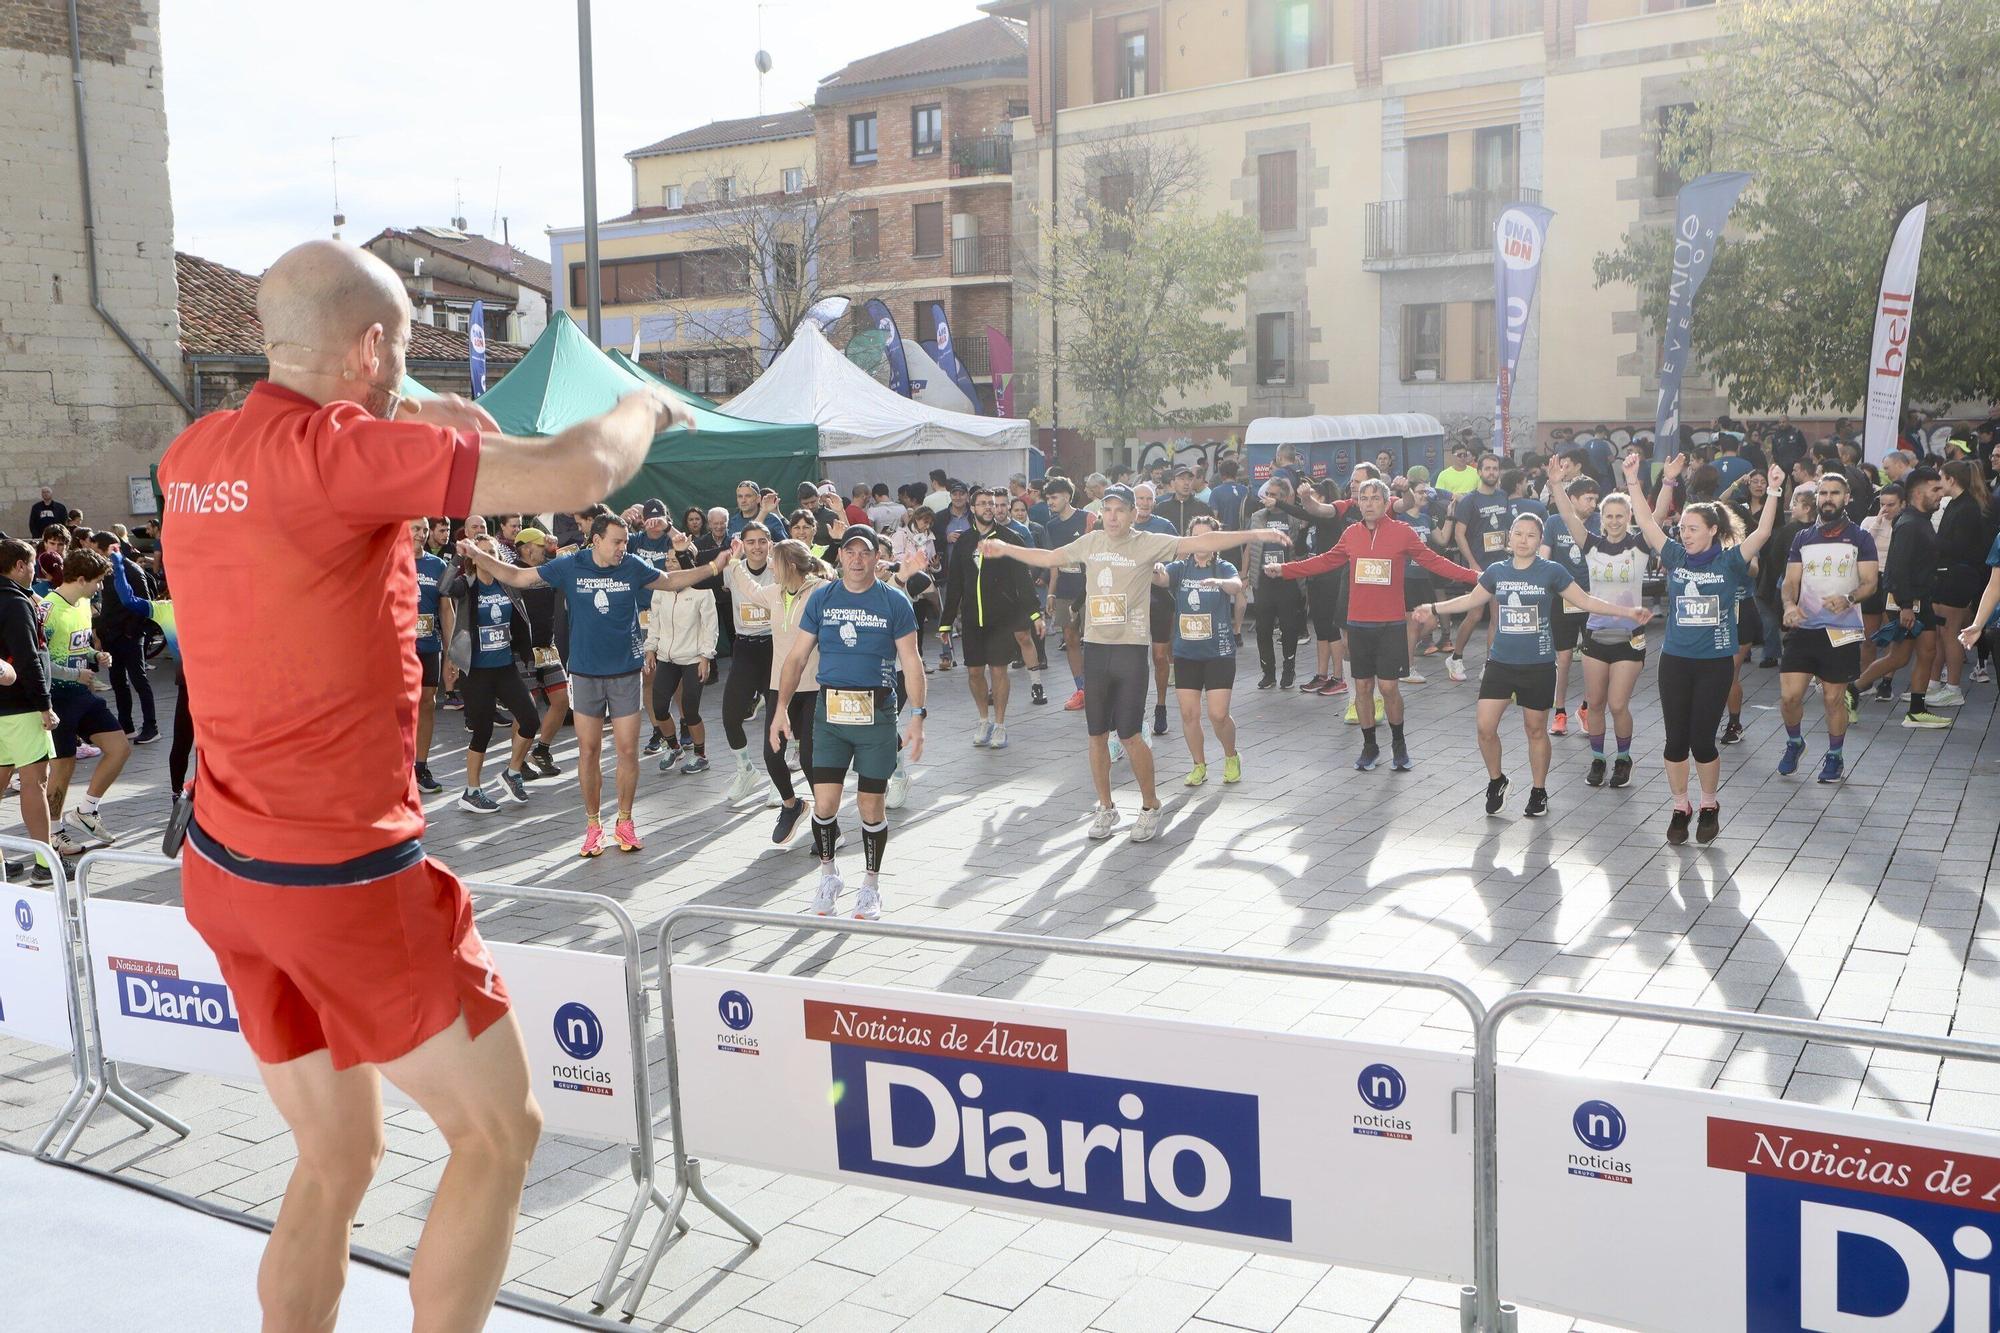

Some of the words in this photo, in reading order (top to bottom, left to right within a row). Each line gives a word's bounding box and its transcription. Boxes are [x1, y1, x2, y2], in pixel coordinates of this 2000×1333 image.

[1876, 291, 1912, 378] bell
[166, 480, 248, 513] FITNESS
[1506, 612, 1531, 624] 1033
[1684, 603, 1709, 615] 1037
[415, 620, 428, 630] 62
[856, 620, 887, 628] KONKISTA
[489, 630, 504, 641] 832
[115, 959, 144, 972] Noticias
[145, 963, 153, 973] de
[126, 976, 224, 1024] Diario
[728, 1001, 743, 1020] n
[567, 1018, 589, 1045] n
[717, 1033, 759, 1047] noticias
[831, 1009, 932, 1047] Noticias
[940, 1023, 968, 1051] de
[974, 1020, 1058, 1062] Álava
[553, 1064, 611, 1084] noticias
[558, 1081, 578, 1089] GRUPO
[586, 1086, 609, 1094] TALDEA
[1371, 1076, 1392, 1099] n
[1353, 1114, 1412, 1130] noticias
[1588, 1113, 1610, 1138] n
[865, 1060, 1231, 1213] Diario
[1568, 1153, 1632, 1173] noticias
[1747, 1132, 1911, 1188] Noticias
[1925, 1159, 1972, 1197] de
[1573, 1169, 1595, 1177] GRUPO
